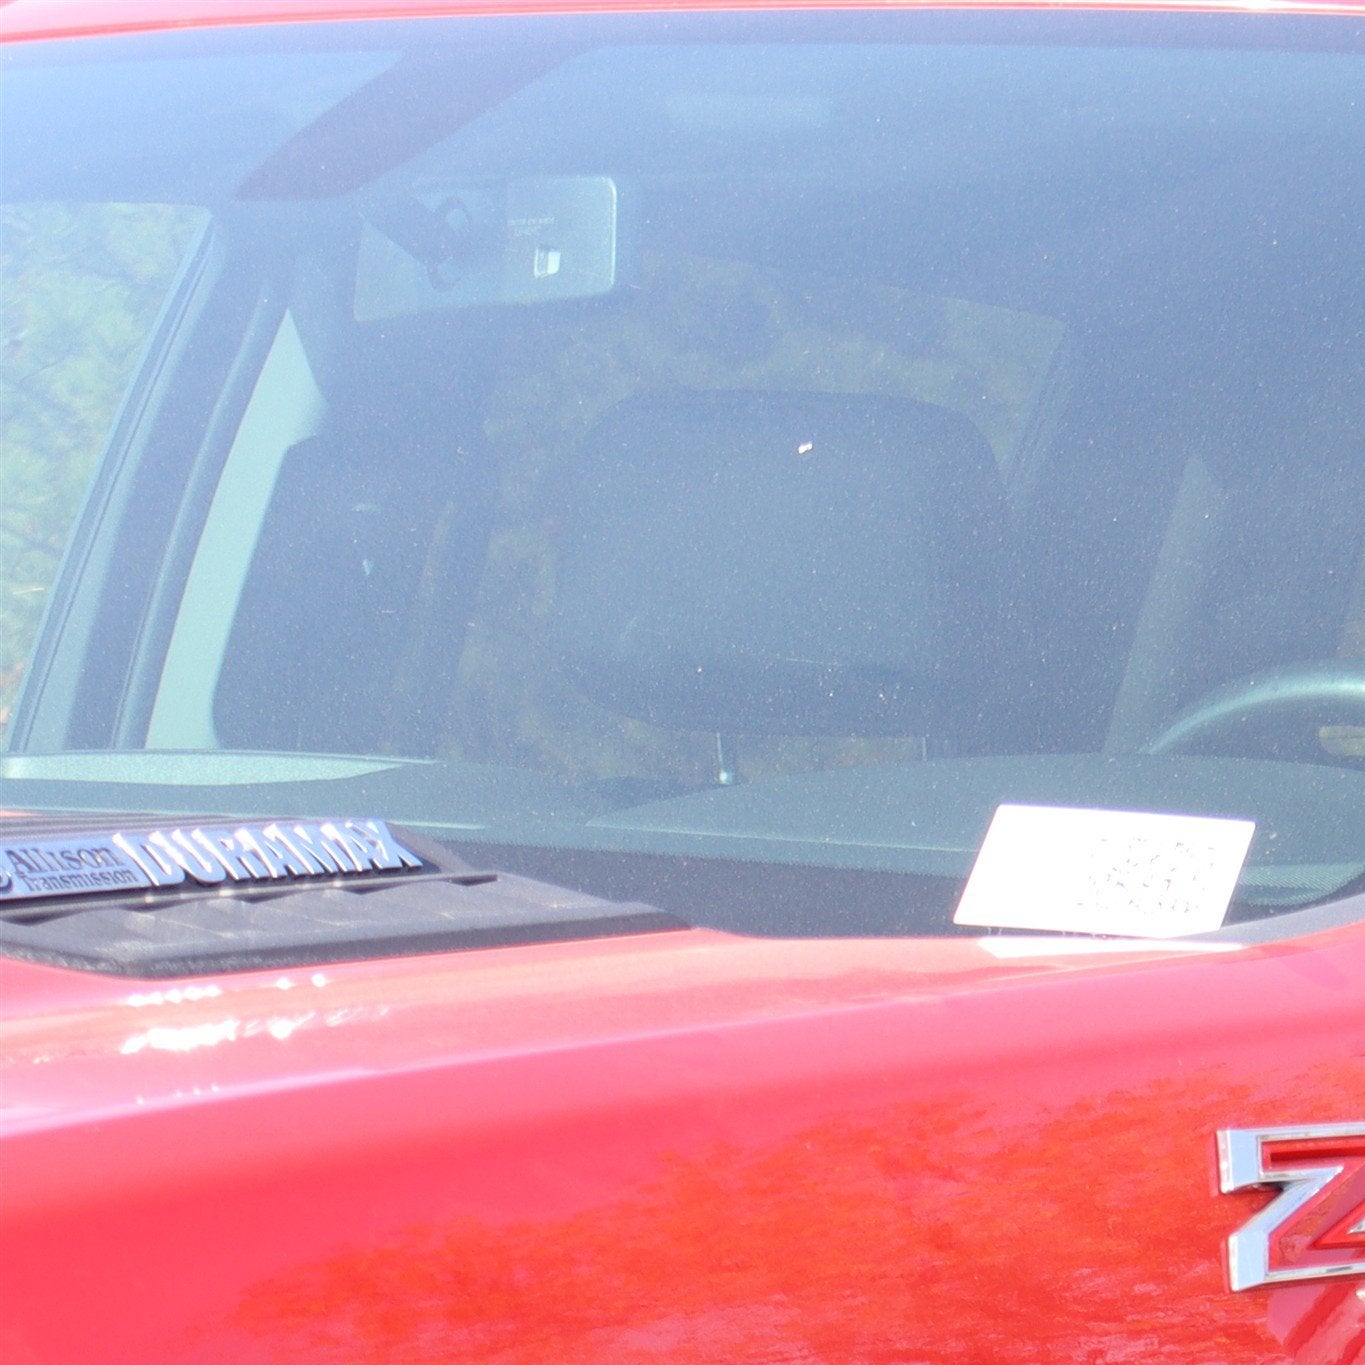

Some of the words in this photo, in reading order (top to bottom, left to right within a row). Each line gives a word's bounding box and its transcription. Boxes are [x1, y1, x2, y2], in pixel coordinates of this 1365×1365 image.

[7, 846, 126, 874] Allison
[112, 821, 423, 887] DURAMAX
[20, 867, 139, 892] Transmission
